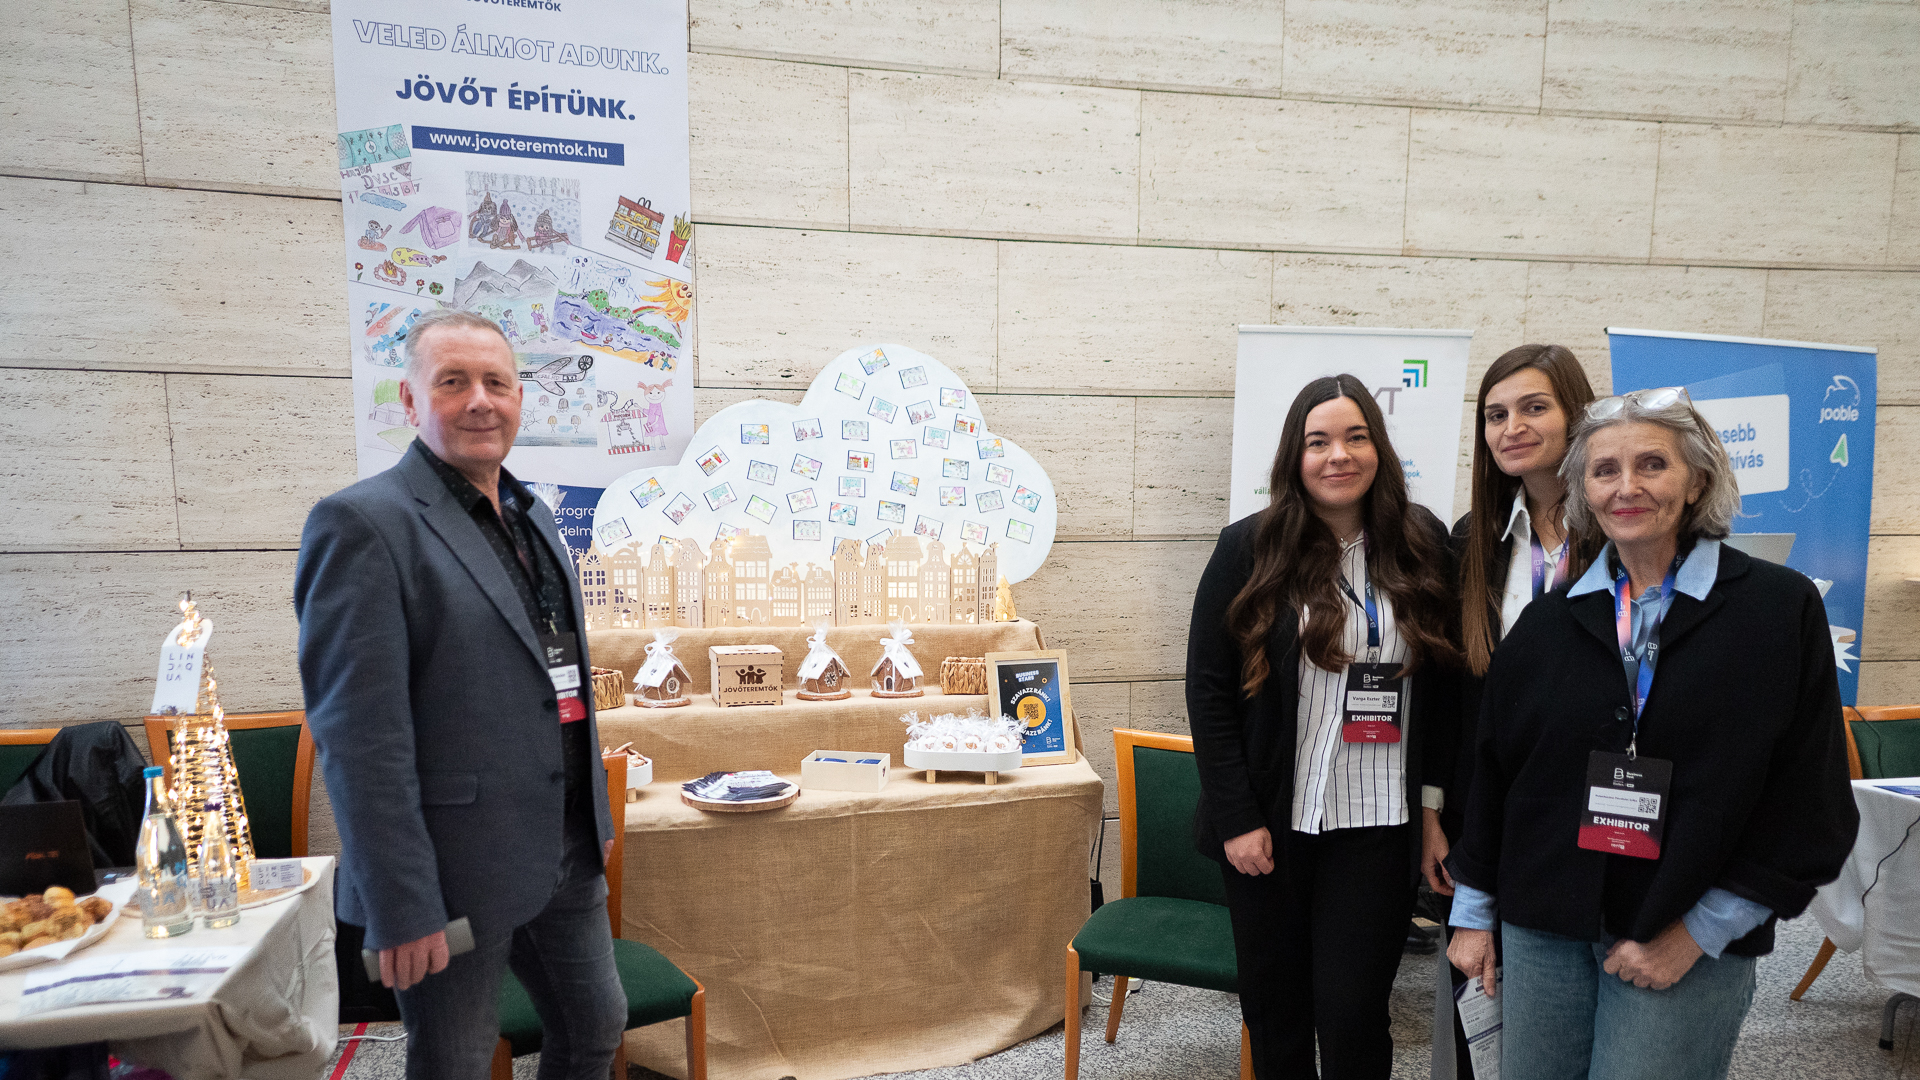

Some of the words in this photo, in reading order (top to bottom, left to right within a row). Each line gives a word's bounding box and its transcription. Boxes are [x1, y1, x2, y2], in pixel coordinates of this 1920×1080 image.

[352, 19, 447, 51] VELED
[451, 24, 554, 62] ÁLMOT
[558, 43, 669, 75] ADUNK.
[396, 73, 498, 108] JÖVŐT
[508, 82, 636, 121] ÉPÍTÜNK.
[429, 131, 608, 160] www.jovoteremtok.hu
[1351, 714, 1393, 722] EXHIBITOR
[1592, 815, 1650, 832] EXHIBITOR
